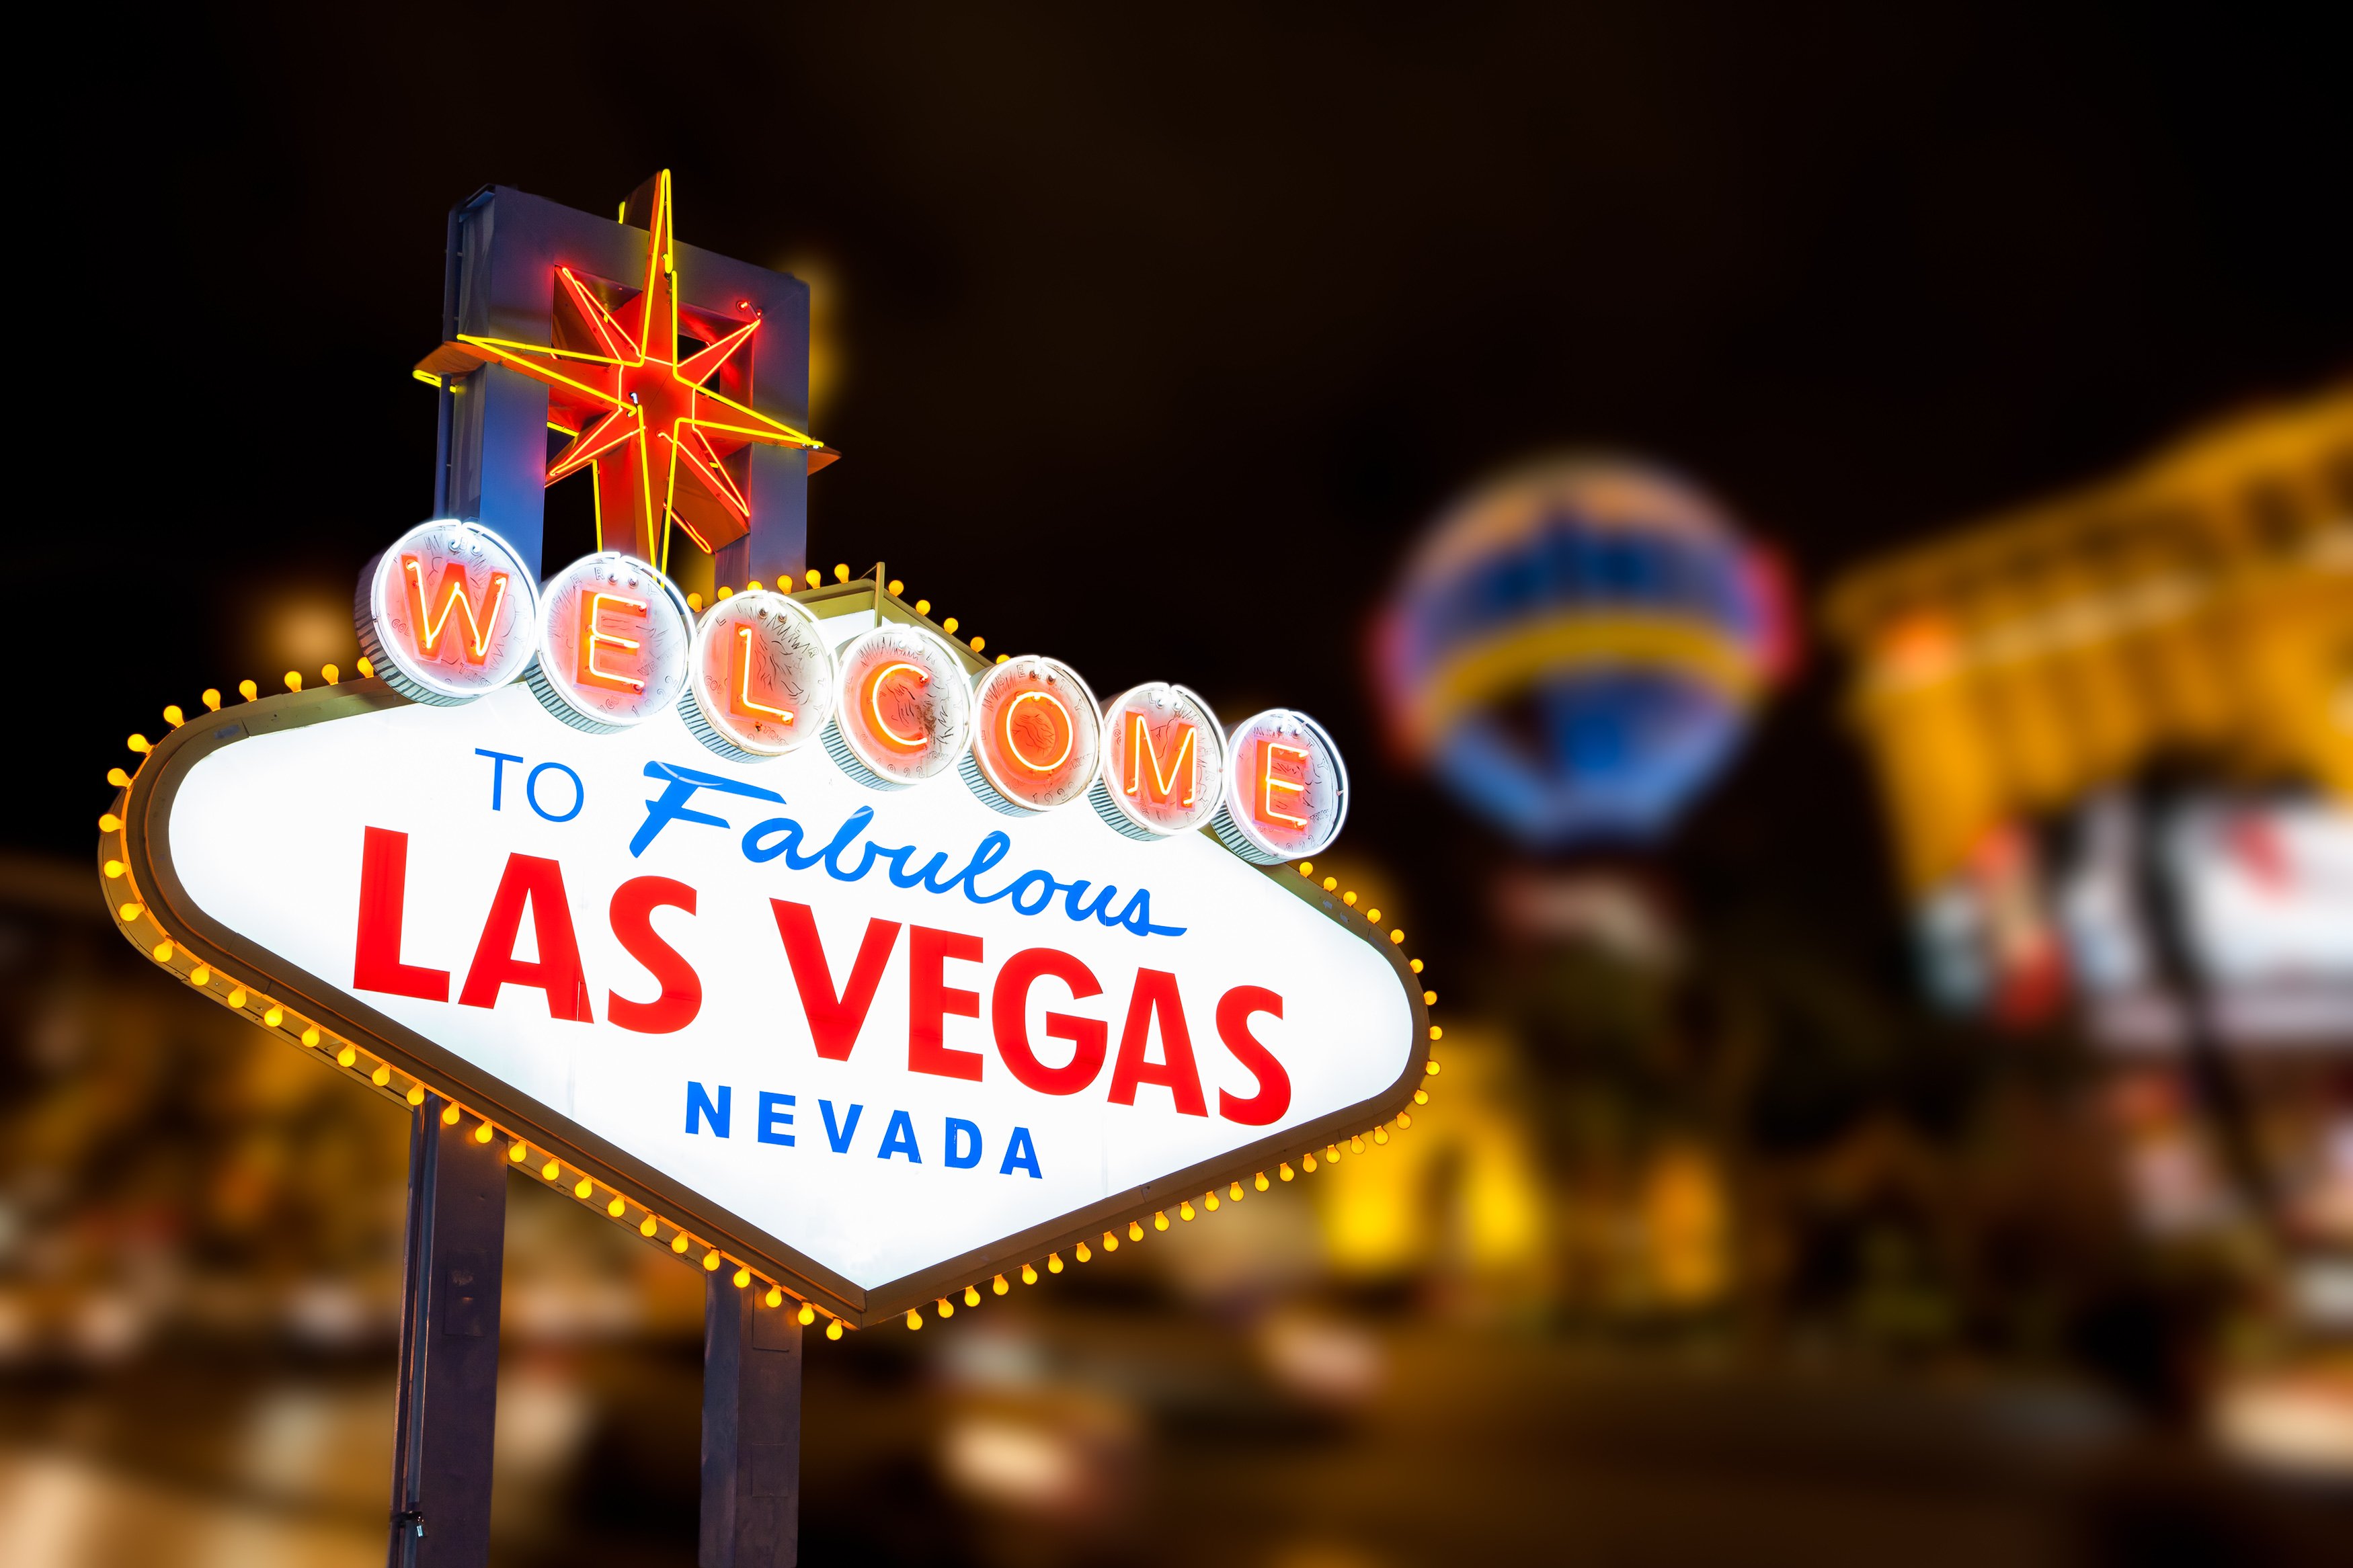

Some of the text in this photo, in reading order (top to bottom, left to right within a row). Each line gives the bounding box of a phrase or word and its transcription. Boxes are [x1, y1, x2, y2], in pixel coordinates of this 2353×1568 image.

[401, 553, 1308, 831] WELCOME
[475, 748, 1188, 937] TO Fabulous
[354, 825, 1292, 1126] LAS VEGAS
[684, 1081, 1043, 1180] NEVADA
